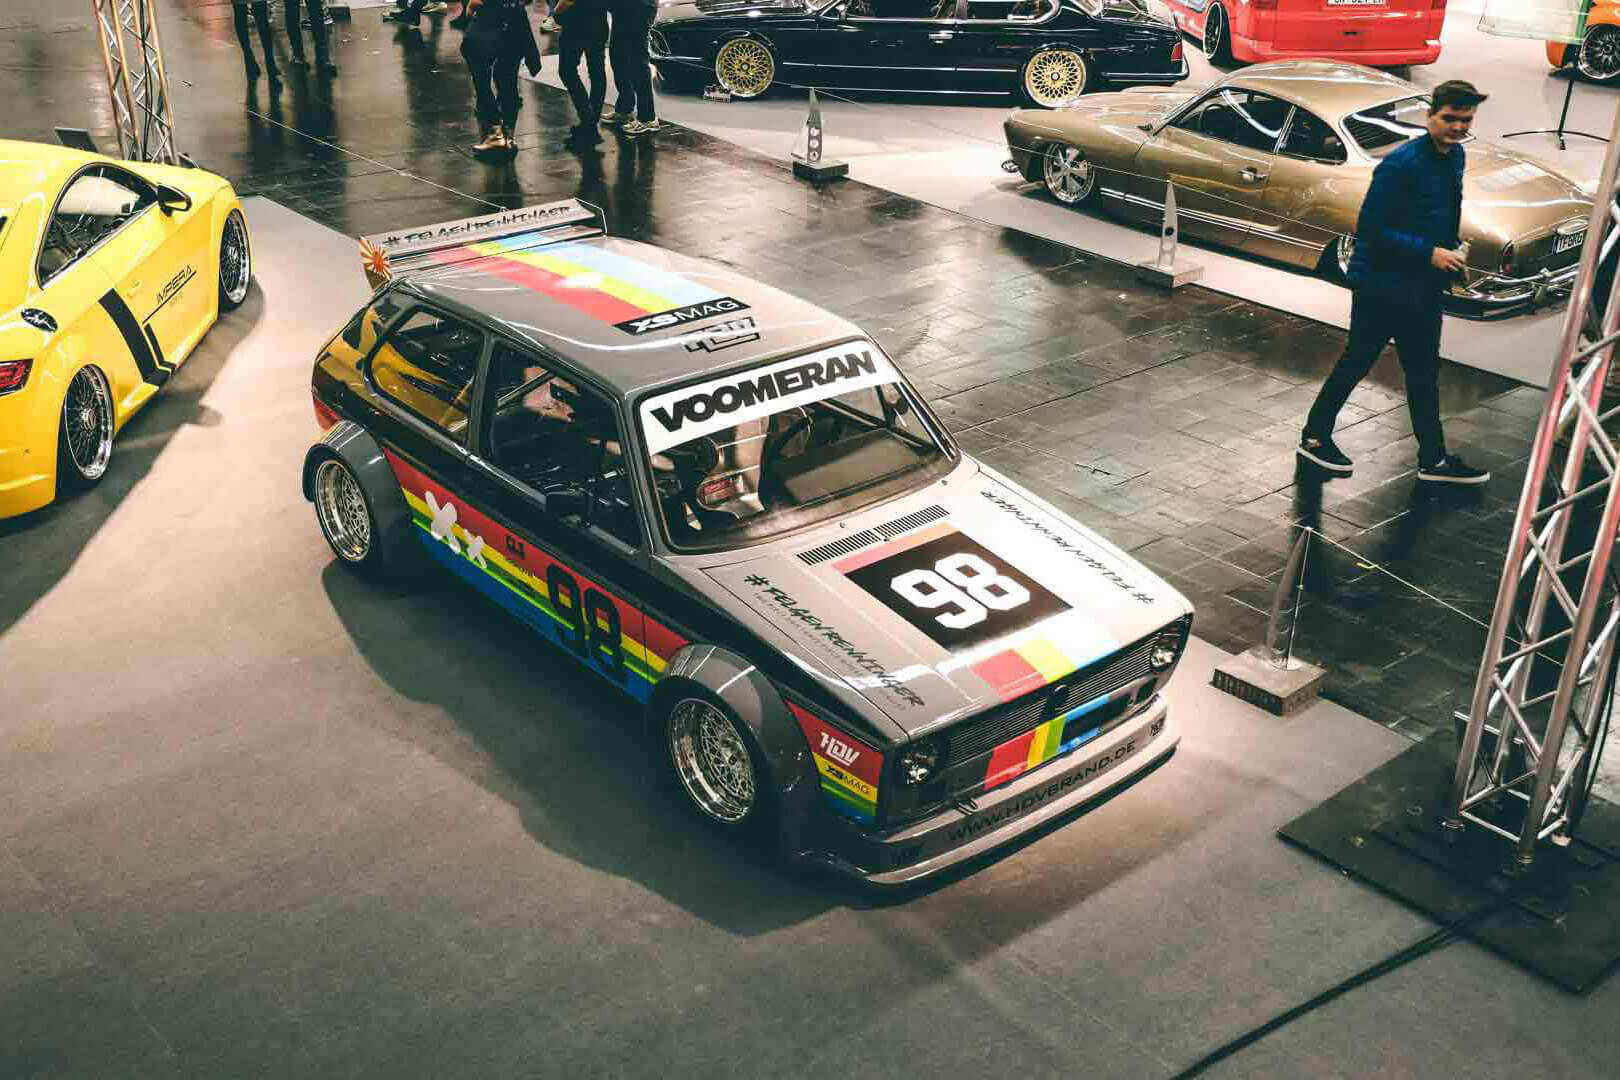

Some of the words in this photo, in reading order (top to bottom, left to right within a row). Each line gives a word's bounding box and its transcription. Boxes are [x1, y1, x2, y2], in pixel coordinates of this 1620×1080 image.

[650, 350, 878, 433] VOOMERAN
[547, 563, 622, 678] 98
[890, 552, 1031, 629] 98
